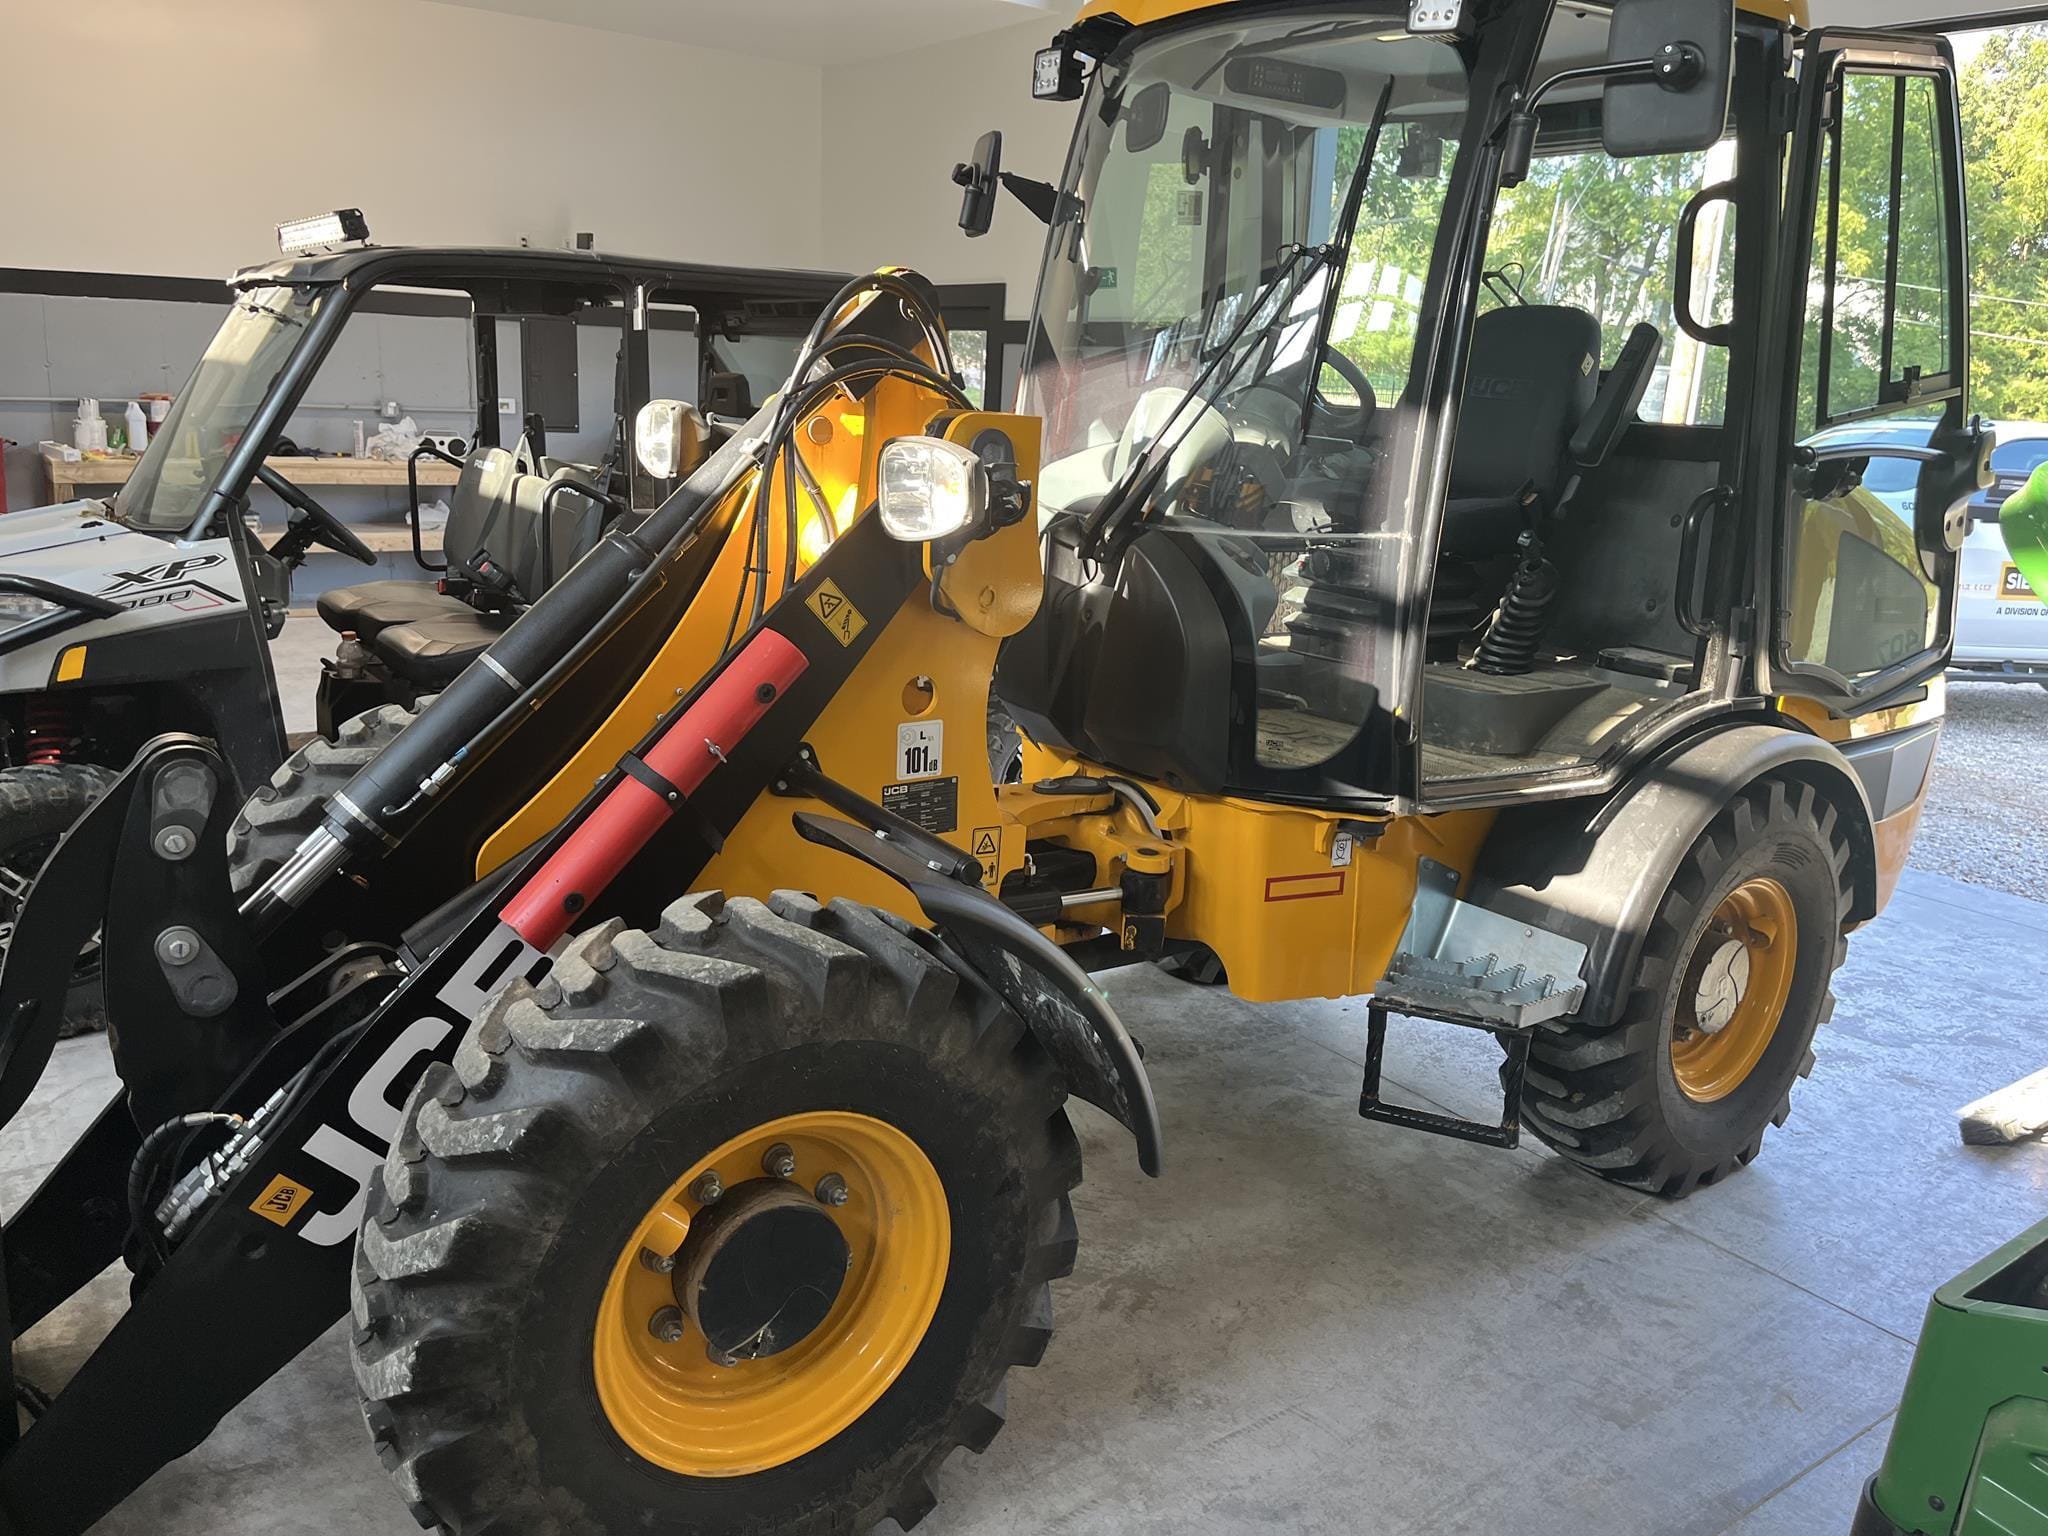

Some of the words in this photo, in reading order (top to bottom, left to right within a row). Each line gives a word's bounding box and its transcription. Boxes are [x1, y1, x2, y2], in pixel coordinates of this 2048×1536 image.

[96, 553, 227, 594] XP
[1996, 607, 2002, 615] A
[2004, 607, 2039, 616] DIVISION
[905, 745, 929, 774] 101
[883, 785, 908, 796] JCB
[269, 1187, 296, 1211] JCB
